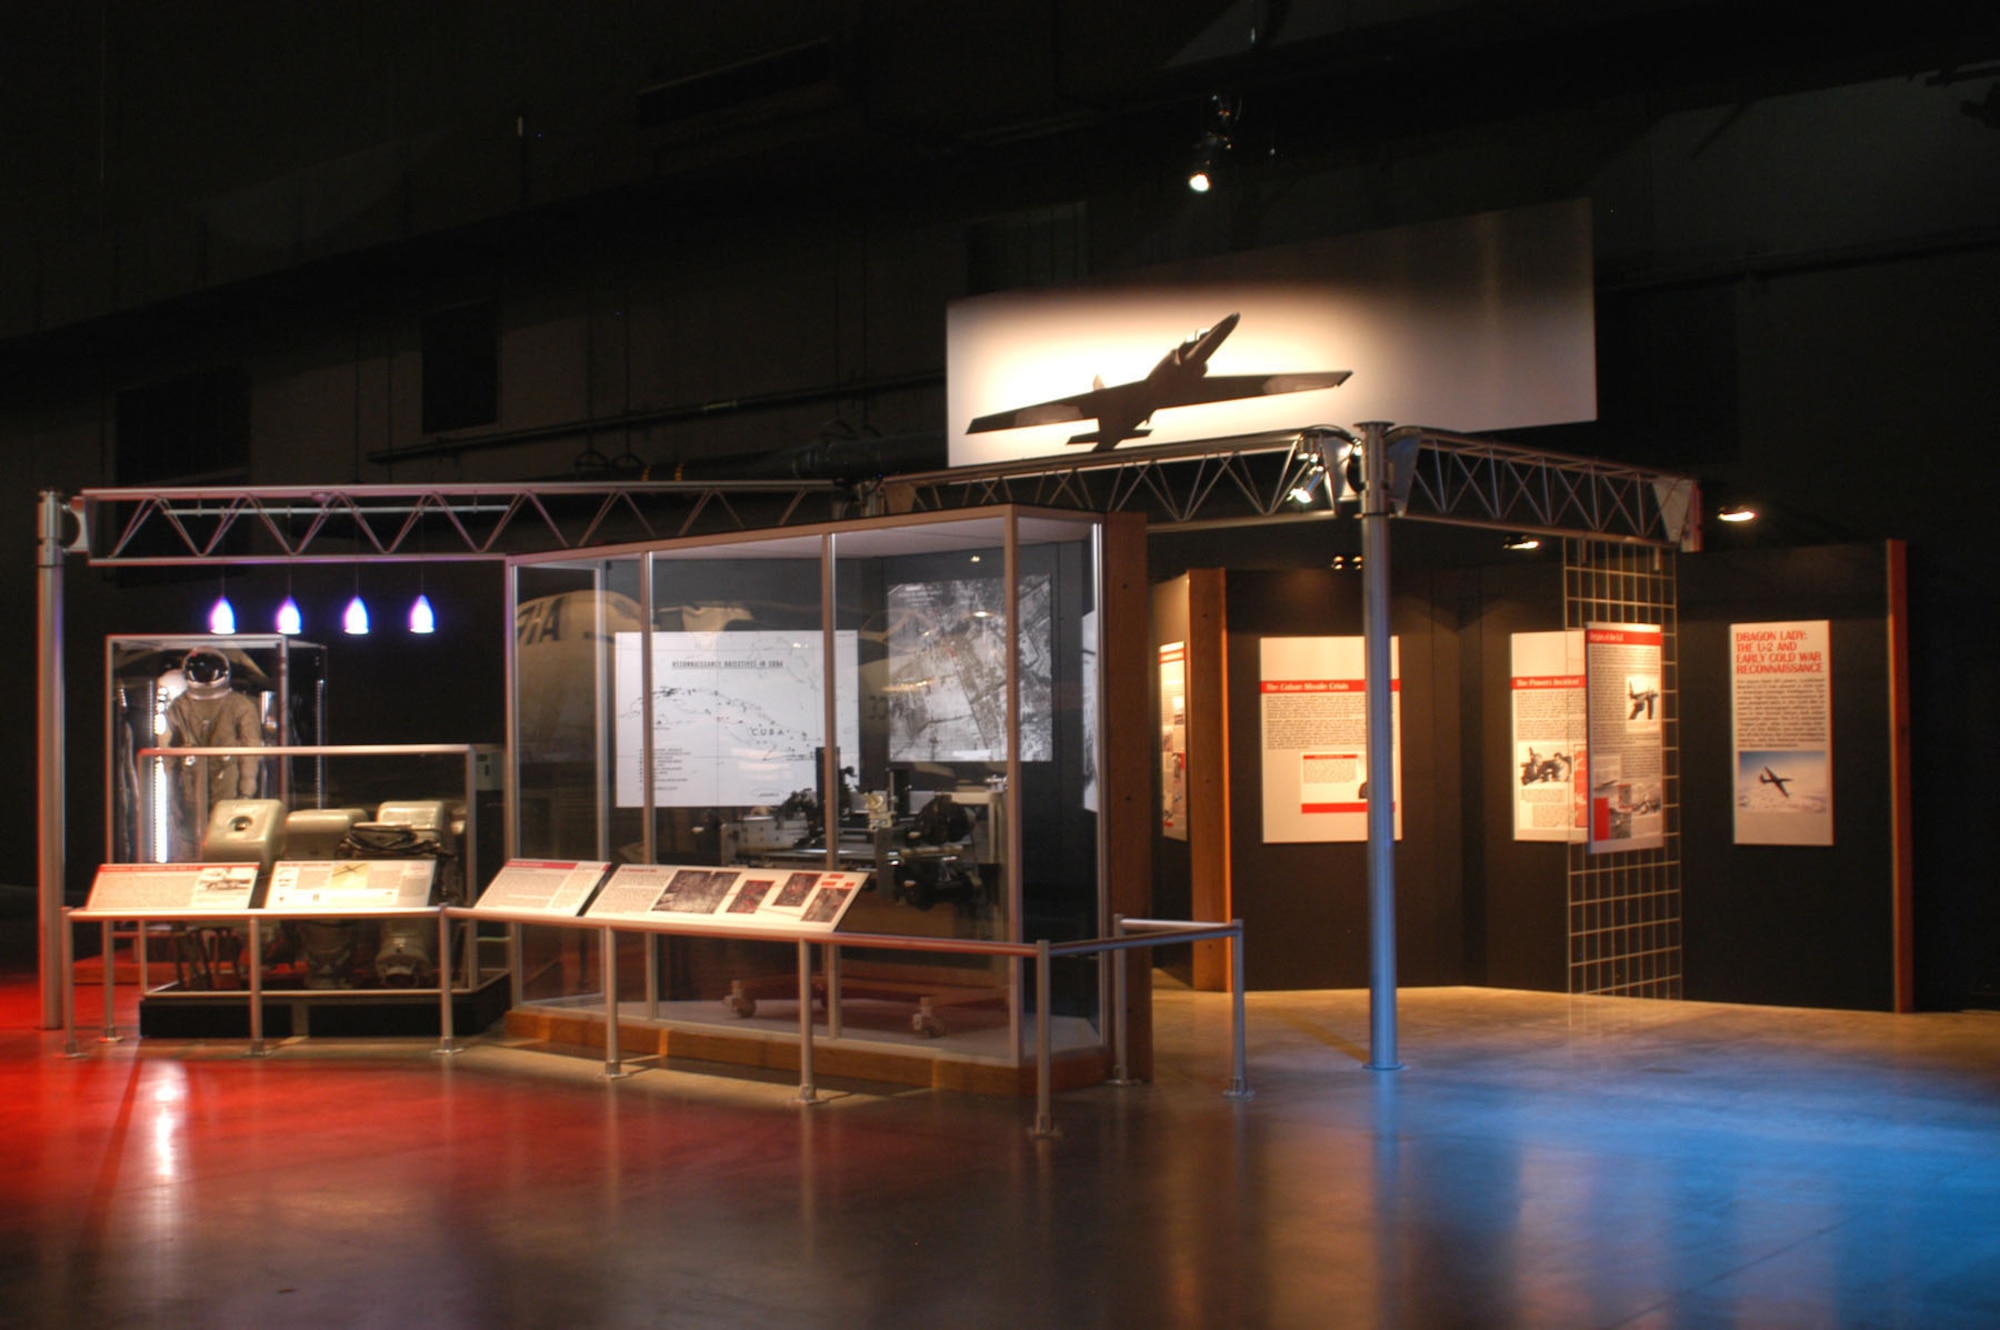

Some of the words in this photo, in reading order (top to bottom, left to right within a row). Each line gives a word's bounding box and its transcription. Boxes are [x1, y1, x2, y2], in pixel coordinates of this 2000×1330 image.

[1736, 632, 1776, 641] DRAGON
[1737, 643, 1752, 652] THE
[1757, 643, 1773, 652] U-2
[1777, 642, 1797, 651] AND
[1736, 654, 1765, 663] EARLY
[1768, 652, 1796, 662] COLD
[1799, 651, 1822, 661] WAR
[1736, 663, 1822, 674] RECONNAISSANCE
[1266, 683, 1279, 691] The
[1280, 683, 1303, 691] Cuban
[1304, 682, 1328, 690] Missile
[1328, 682, 1349, 690] Crisis
[1516, 678, 1528, 687] The
[751, 728, 784, 736] CUBA
